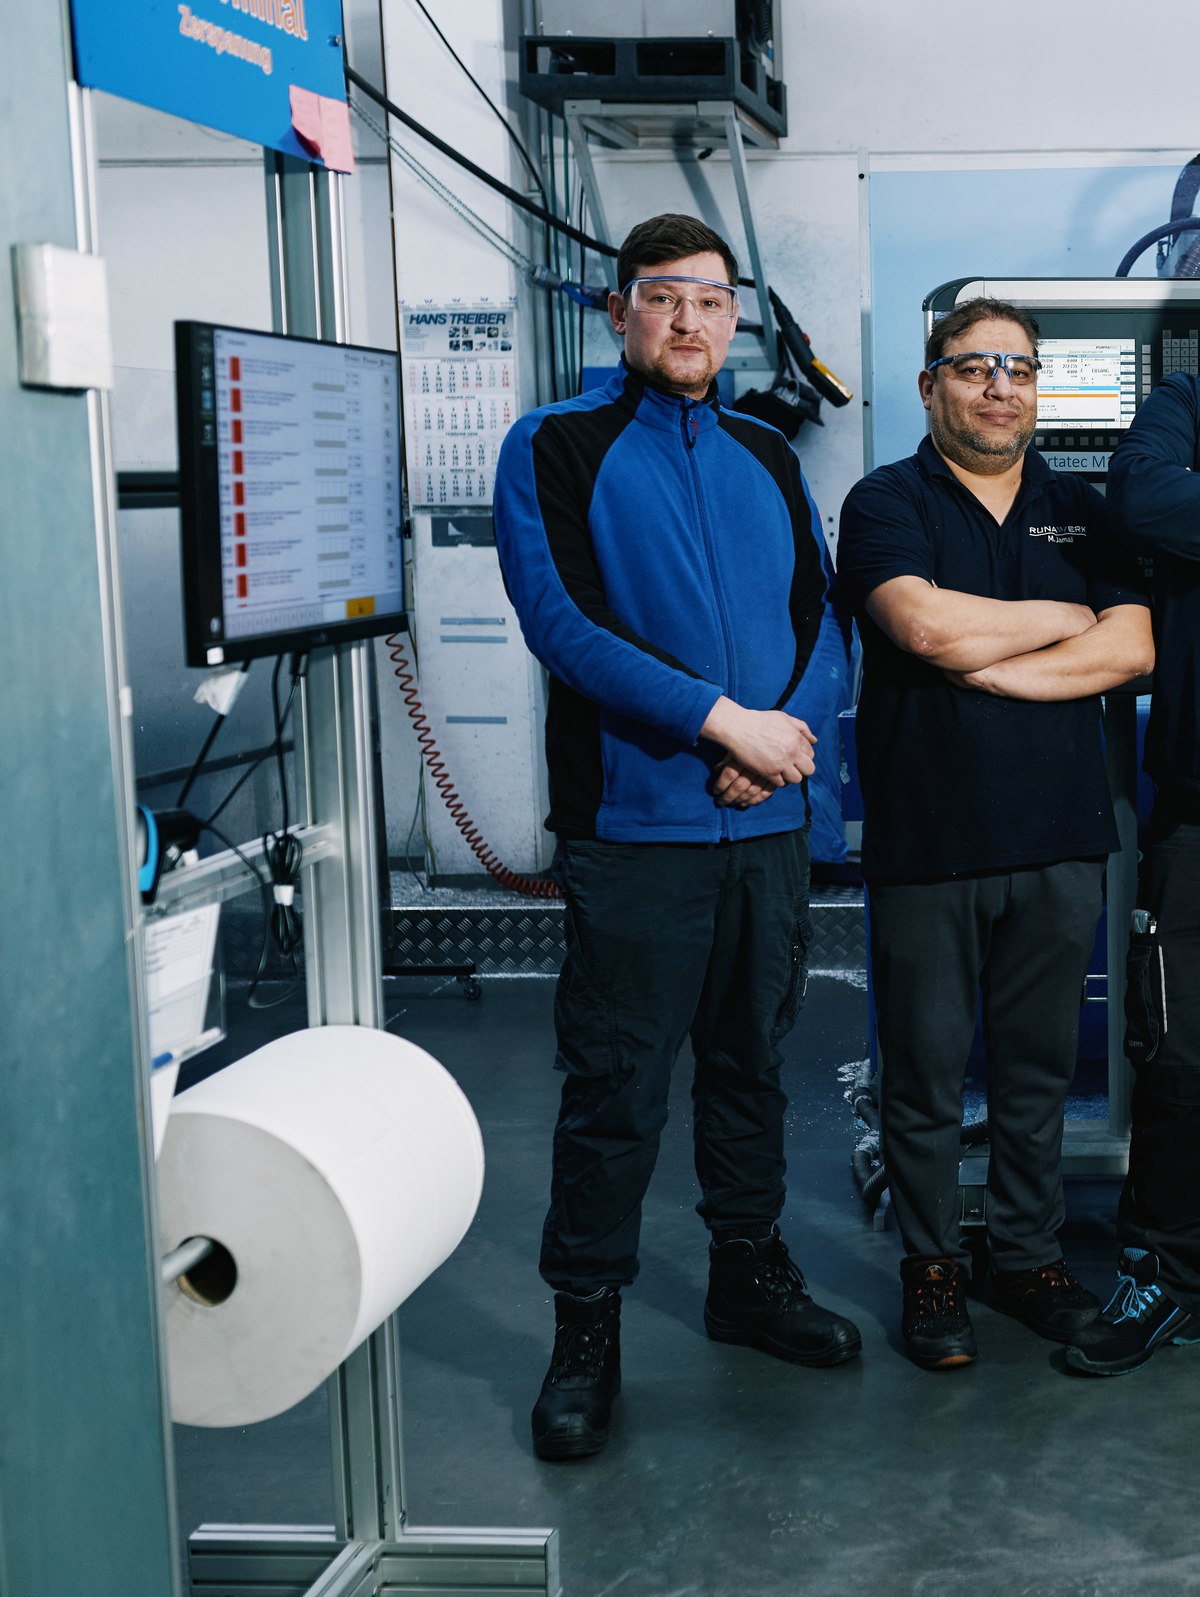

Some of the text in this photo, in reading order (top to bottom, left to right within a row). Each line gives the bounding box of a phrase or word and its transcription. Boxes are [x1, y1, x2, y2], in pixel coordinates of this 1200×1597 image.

[178, 4, 272, 75] Zerspanung
[409, 312, 506, 324] HANS TREIBER
[1092, 456, 1107, 468] M
[1029, 526, 1086, 534] RUNAWERK
